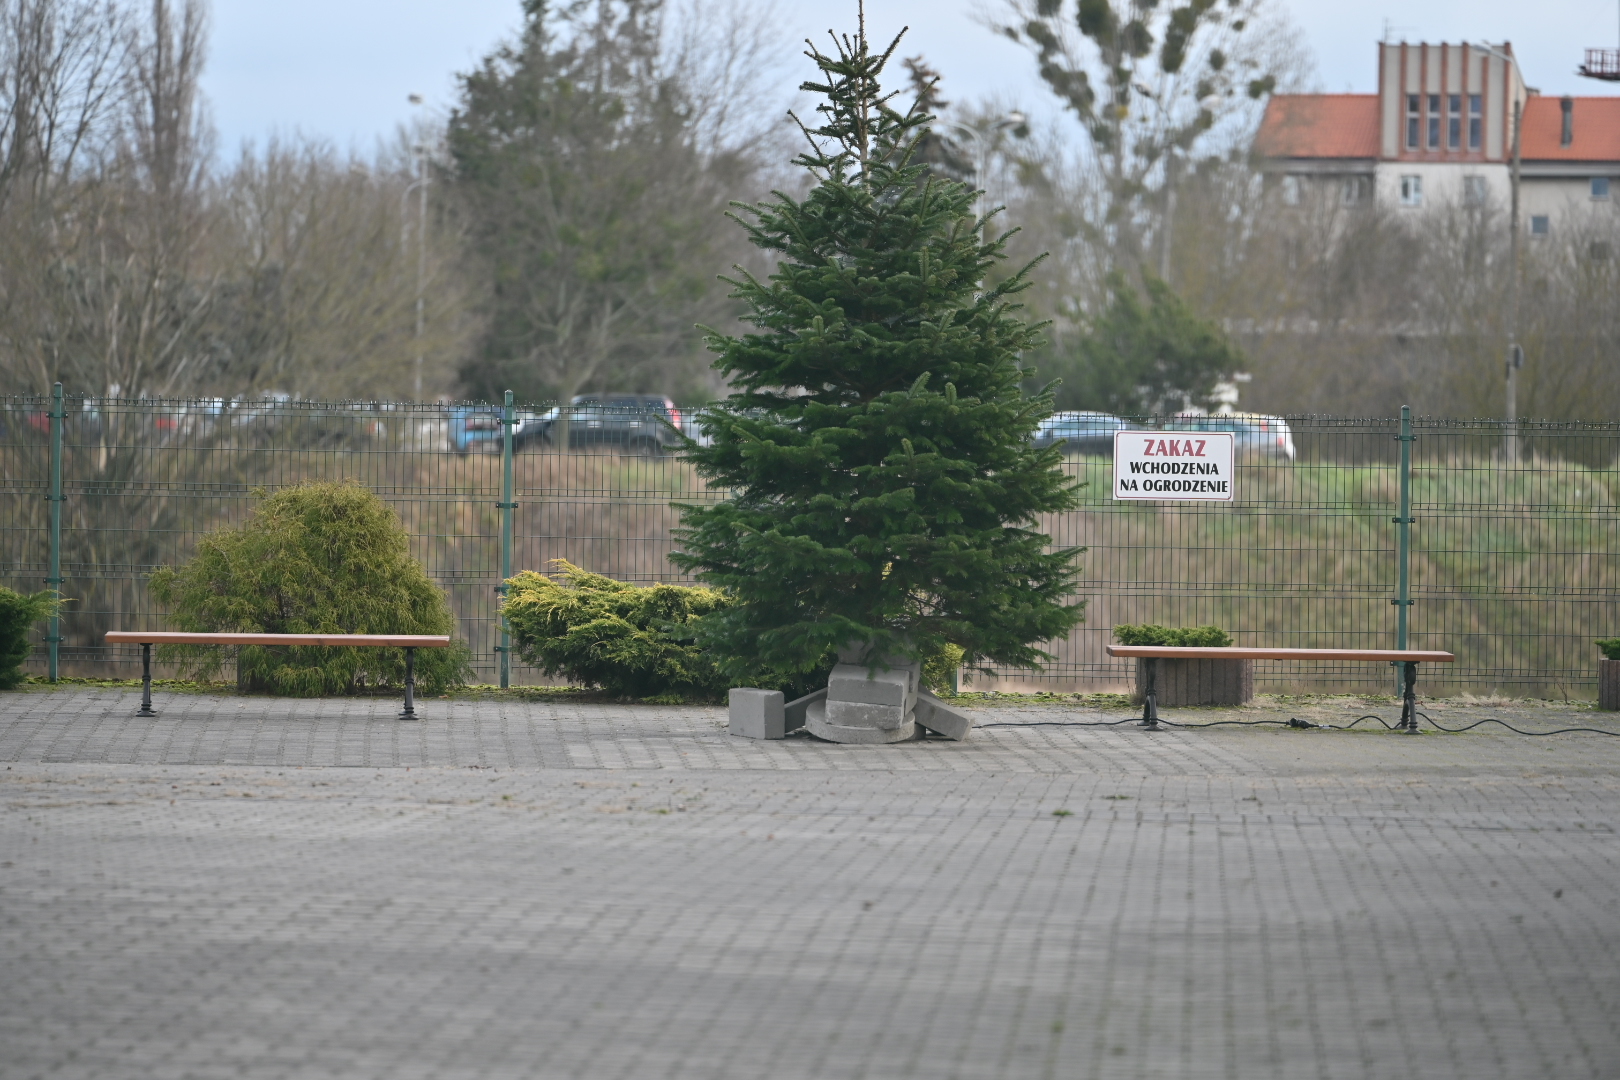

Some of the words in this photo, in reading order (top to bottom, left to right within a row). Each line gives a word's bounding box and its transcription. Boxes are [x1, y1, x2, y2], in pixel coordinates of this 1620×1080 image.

[1144, 439, 1206, 457] ZAKAZ
[1129, 461, 1219, 475] WCHODZENIA
[1120, 479, 1138, 491] NA
[1143, 479, 1228, 492] OGRODZENIE
